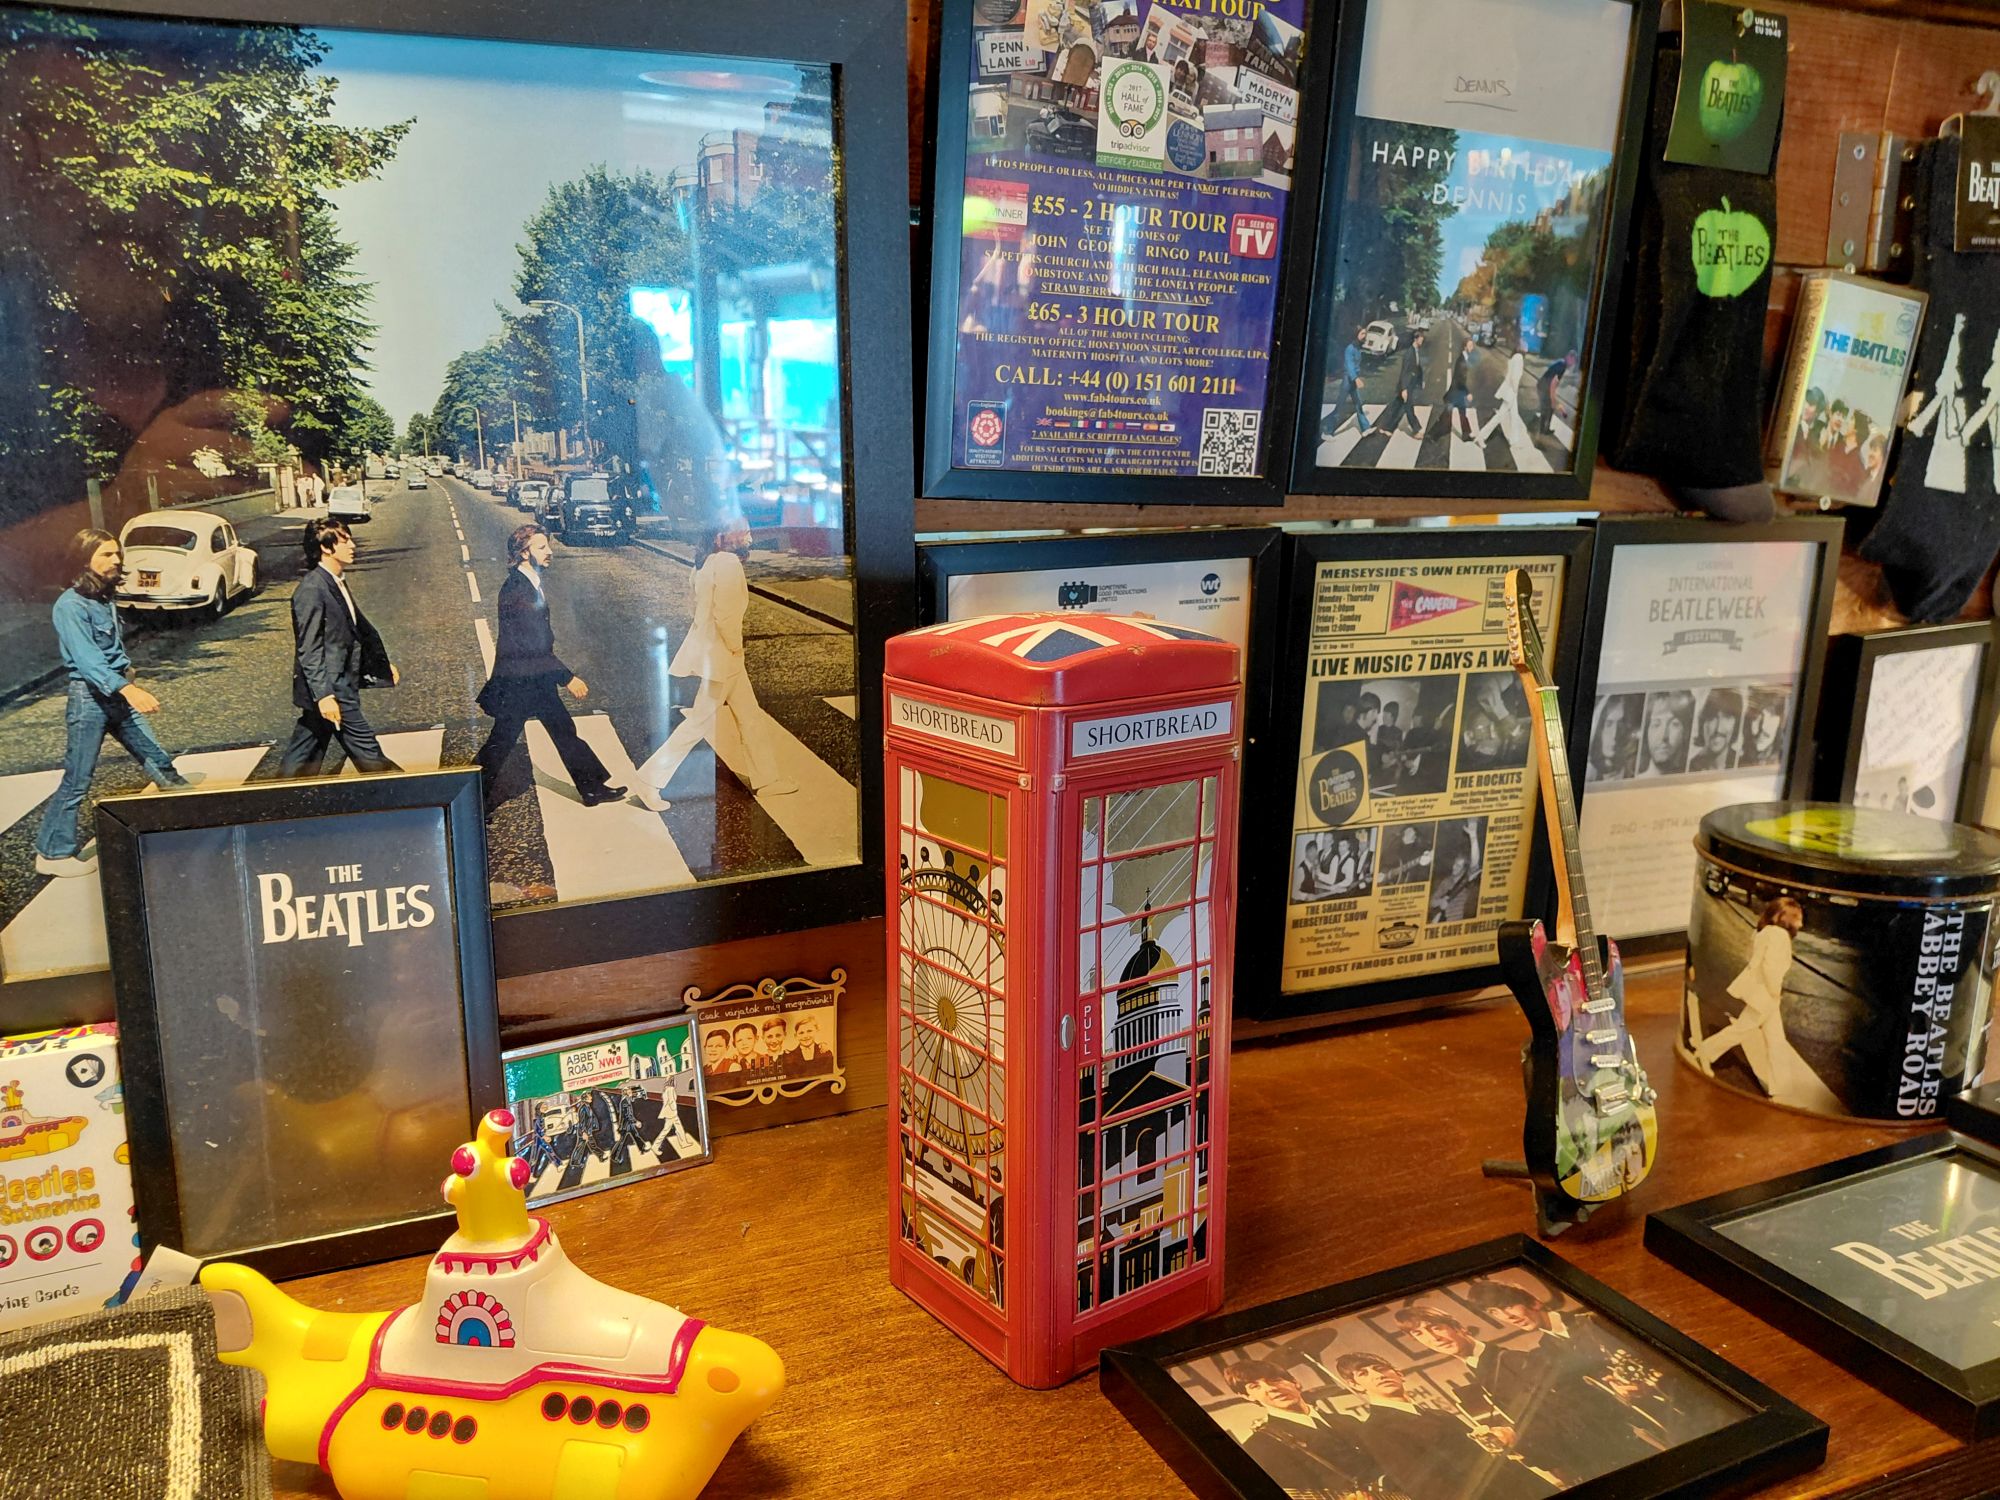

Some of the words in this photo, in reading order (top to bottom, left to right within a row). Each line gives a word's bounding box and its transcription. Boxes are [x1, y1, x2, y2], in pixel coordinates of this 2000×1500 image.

[990, 41, 1029, 53] PENN
[989, 56, 1021, 68] LANE
[1121, 92, 1140, 101] HALL
[1249, 81, 1293, 107] MADRYN
[1453, 76, 1512, 97] DENNIS
[1123, 103, 1144, 113] FAME
[1110, 140, 1151, 152] tripadvisor
[1372, 141, 1456, 172] HAPPY
[1019, 161, 1055, 173] PEOPLE
[1056, 166, 1069, 175] OR
[1098, 172, 1114, 181] ALL
[1116, 174, 1147, 185] PRICES
[1150, 178, 1166, 188] ARE
[1168, 180, 1184, 189] PER
[1222, 186, 1238, 196] PER
[1093, 182, 1105, 191] NO
[1107, 184, 1140, 197] HIDDEN
[1432, 183, 1526, 214] DENNIS
[1032, 194, 1066, 216] £55
[1082, 200, 1093, 220] 2
[1168, 210, 1227, 234] TOUR
[1083, 225, 1101, 236] SEE
[1129, 230, 1165, 242] HOMES
[1167, 233, 1181, 243] OF
[1236, 228, 1274, 255] TV
[1717, 229, 1739, 242] THE
[1029, 234, 1067, 249] JOHN
[1146, 245, 1189, 261] RINGO
[1198, 250, 1232, 265] PAUL
[1044, 255, 1090, 269] CHURCH
[1092, 259, 1113, 271] AND
[1193, 269, 1239, 282] ELEANOR
[1241, 273, 1272, 285] RIGBY
[1040, 281, 1113, 297] STRAWBERRY
[1151, 291, 1182, 303] PENNY
[1086, 273, 1108, 283] AND
[1133, 276, 1153, 287] THE
[1155, 279, 1196, 292] LONELY
[1027, 302, 1061, 322] £65
[1077, 305, 1088, 324] 3
[1094, 307, 1156, 329] HOUR
[1162, 311, 1220, 334] TOUR
[975, 332, 994, 342] THE
[997, 334, 1046, 345] REGISTRY
[1088, 340, 1150, 352] HONEYMOON
[1182, 347, 1201, 356] ART
[1058, 327, 1075, 336] ALL
[1077, 328, 1089, 337] OF
[1090, 329, 1108, 339] THE
[1112, 331, 1139, 341] ABOVE
[1141, 332, 1190, 344] INCLUDING:
[1031, 349, 1089, 361] MATERNITY
[1091, 352, 1136, 364] HOSPITAL
[1139, 355, 1157, 364] AND
[1159, 356, 1183, 366] LOTS
[1184, 358, 1214, 368] MORE!
[1824, 330, 1850, 353] THE
[1851, 338, 1906, 368] BEATLES
[995, 364, 1062, 386] CALL:
[1068, 370, 1100, 388] +44
[1105, 371, 1129, 394] (0)
[1135, 372, 1163, 392] 151
[1168, 375, 1196, 394] 601
[1201, 376, 1236, 395] 2111
[1064, 392, 1162, 407] www.fab4tours.co.uk
[1040, 430, 1085, 440] AVAILABLE
[1087, 432, 1128, 441] SCRIPTED
[1321, 567, 1418, 579] MERSEYSIDE'S
[1421, 566, 1453, 576] OWN
[1668, 576, 1753, 592] INTERNATIONAL
[1649, 594, 1767, 622] BEATLEWEEK
[1312, 657, 1349, 677] LIVE
[1353, 654, 1413, 676] MUSIC
[1418, 653, 1427, 671] 7
[1430, 651, 1473, 670] DAYS
[1477, 650, 1488, 668] A
[901, 703, 1004, 745] SHORTBREAD
[1087, 710, 1218, 749] SHORTBREAD
[1455, 775, 1474, 789] THE
[324, 863, 364, 884] THE
[256, 872, 435, 948] BEATLES
[1306, 906, 1320, 916] THE
[1383, 930, 1412, 942] VOX
[1940, 911, 1966, 974] THE
[1296, 968, 1315, 979] THE
[1318, 963, 1348, 976] MOST
[1351, 957, 1394, 971] FAMOUS
[1397, 953, 1423, 966] CLUB
[1426, 951, 1437, 960] IN
[1440, 949, 1457, 959] THE
[1460, 943, 1495, 955] WORLD
[1911, 912, 1946, 1018] ABBEY
[567, 1049, 600, 1066] ABBEY
[1918, 983, 1954, 1116] BEATLES
[568, 1062, 594, 1077] ROAD
[598, 1055, 622, 1069] NW8
[1897, 1032, 1928, 1116] ROAD
[1888, 1220, 1940, 1241] THE
[1830, 1226, 2000, 1300] BEATL
[35, 1284, 80, 1303] Cards
